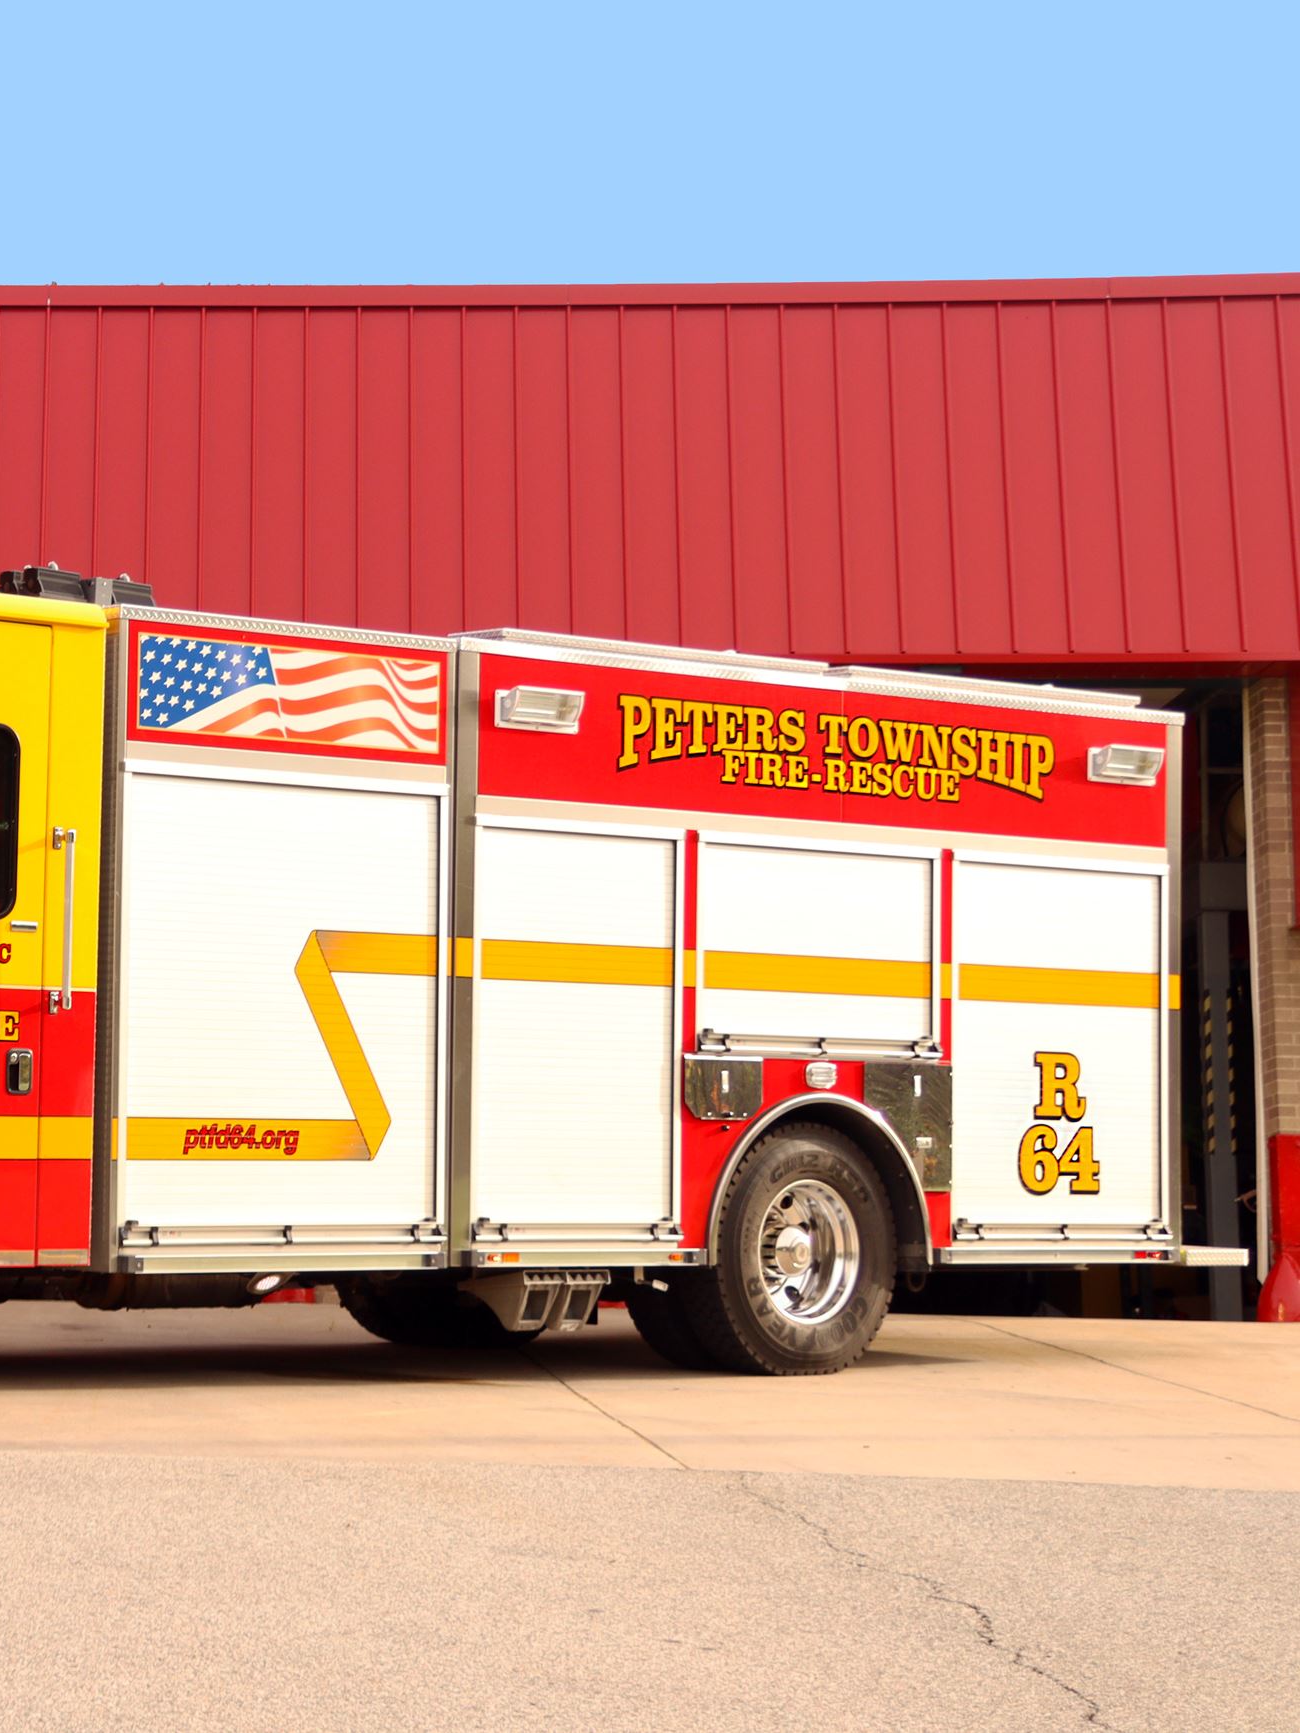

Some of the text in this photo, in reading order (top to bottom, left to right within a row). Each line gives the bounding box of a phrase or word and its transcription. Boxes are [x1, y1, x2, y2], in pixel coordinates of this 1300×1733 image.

[616, 693, 1055, 800] PETERS TOWNSHIP
[720, 748, 960, 802] FIRE-RESCUE
[1033, 1051, 1087, 1123] R
[183, 1123, 300, 1155] ptfd64.org
[1018, 1123, 1100, 1196] 64
